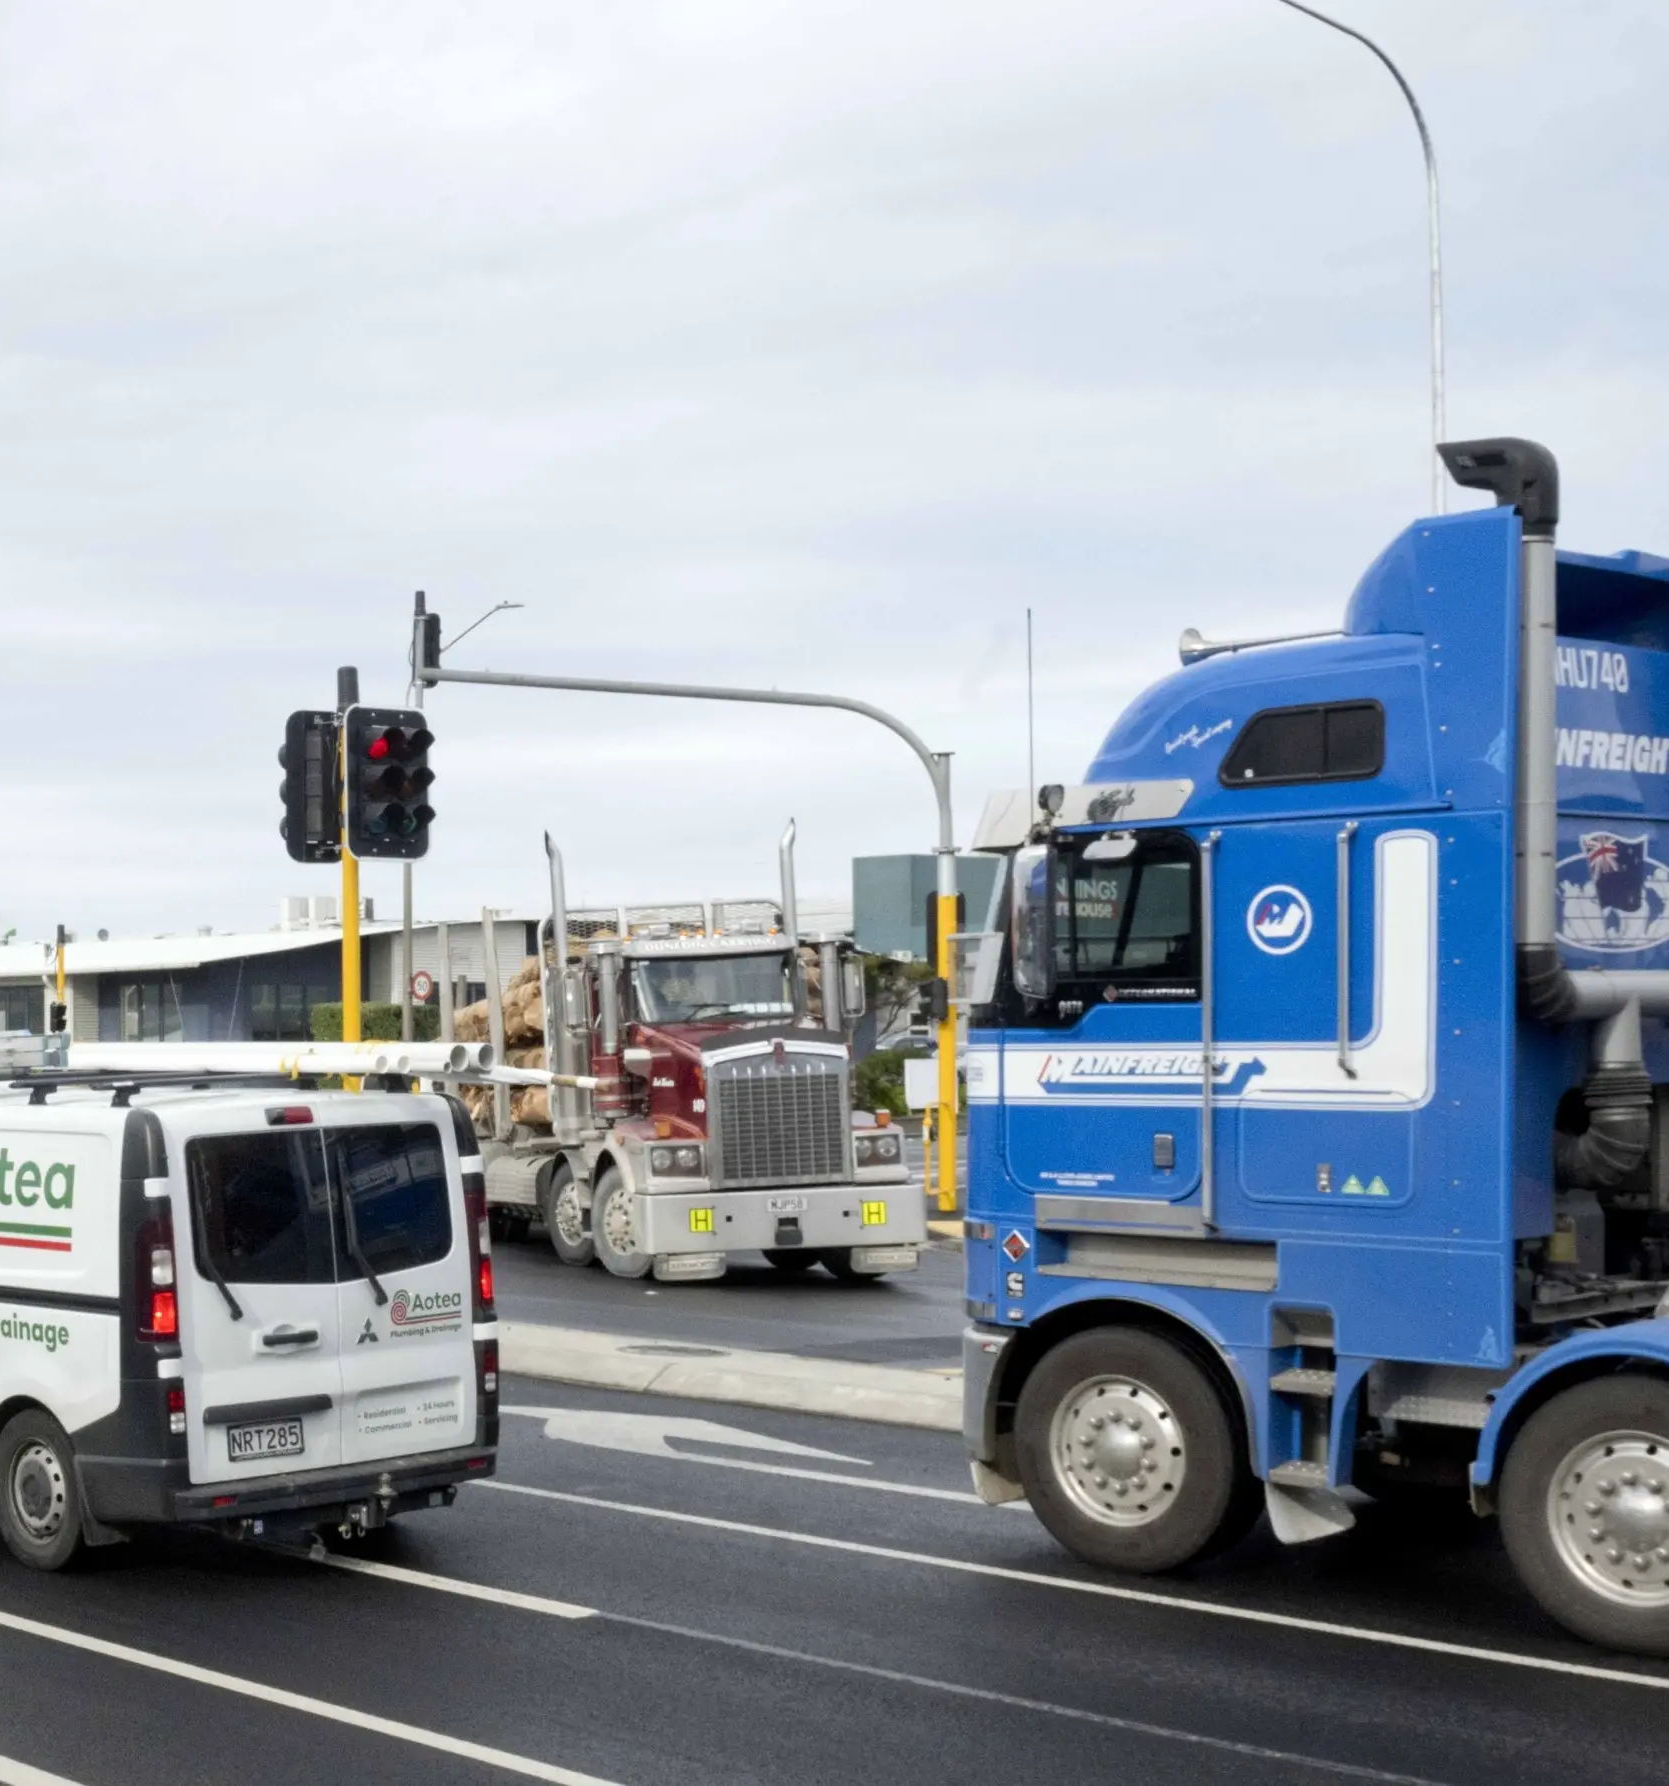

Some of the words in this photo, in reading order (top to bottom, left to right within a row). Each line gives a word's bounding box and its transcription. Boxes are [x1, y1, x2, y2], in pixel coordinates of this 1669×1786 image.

[1556, 646, 1629, 693] HU740
[1555, 727, 1669, 775] NFREIGH
[417, 980, 428, 992] 50
[694, 1210, 709, 1231] H
[867, 1203, 882, 1223] H
[411, 1292, 461, 1312] Aotea
[390, 1327, 424, 1338] Plumbing
[363, 1406, 407, 1420] Residential
[432, 1400, 455, 1409] Hours
[364, 1420, 412, 1434] Commercial
[424, 1413, 459, 1425] Servicing
[231, 1424, 300, 1454] NRT285
